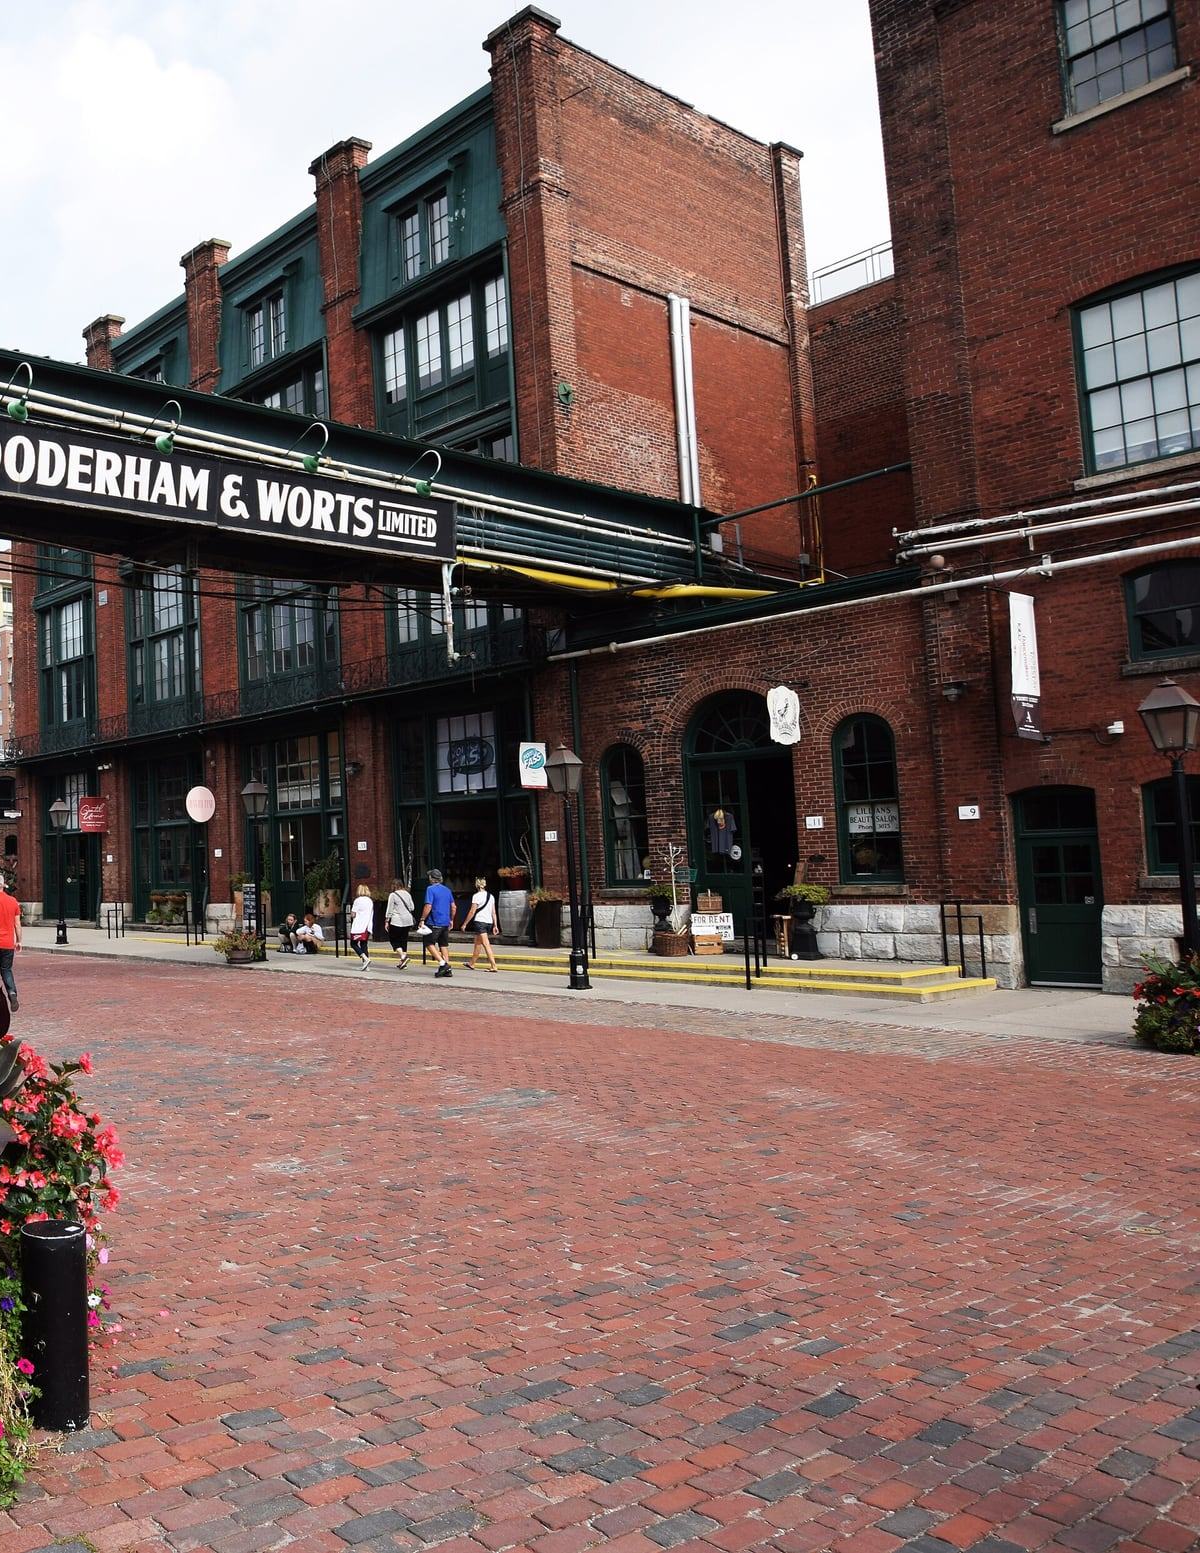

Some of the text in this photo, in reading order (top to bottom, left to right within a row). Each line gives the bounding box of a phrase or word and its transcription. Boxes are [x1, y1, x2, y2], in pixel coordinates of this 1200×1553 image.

[220, 474, 251, 519] &
[256, 478, 374, 537] WORTS
[377, 509, 438, 538] LIMITED
[970, 807, 976, 816] 9
[875, 815, 898, 823] SALON
[693, 915, 730, 924] FOR RENT
